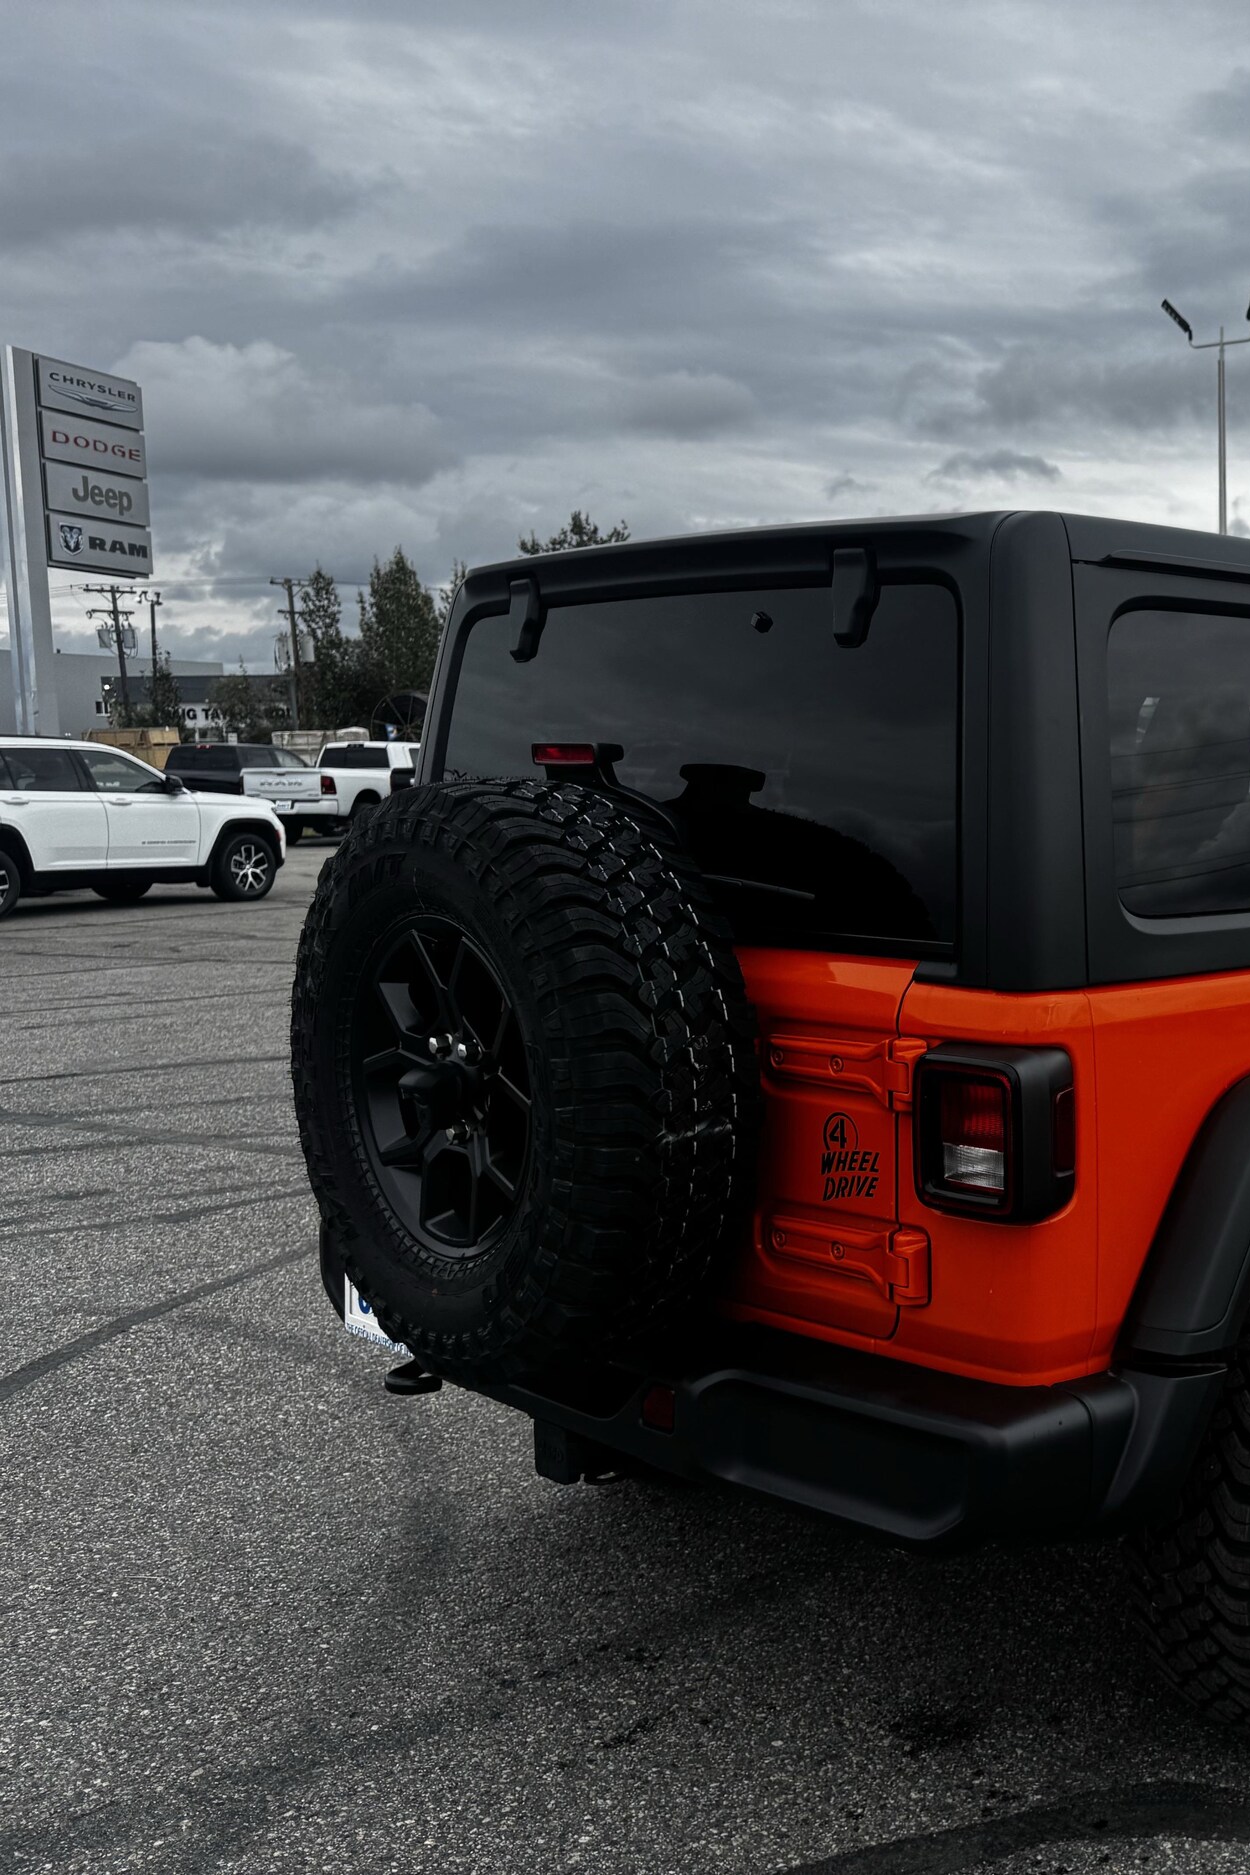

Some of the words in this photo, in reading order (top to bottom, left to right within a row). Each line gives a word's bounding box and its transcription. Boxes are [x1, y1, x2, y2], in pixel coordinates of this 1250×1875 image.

[49, 372, 137, 403] CHRYSLER
[51, 430, 142, 462] DODGE
[72, 475, 133, 516] Jeep
[88, 535, 148, 559] RAM
[829, 1119, 847, 1149] 4
[821, 1150, 879, 1175] WHEEL
[822, 1175, 880, 1202] DRIVE
